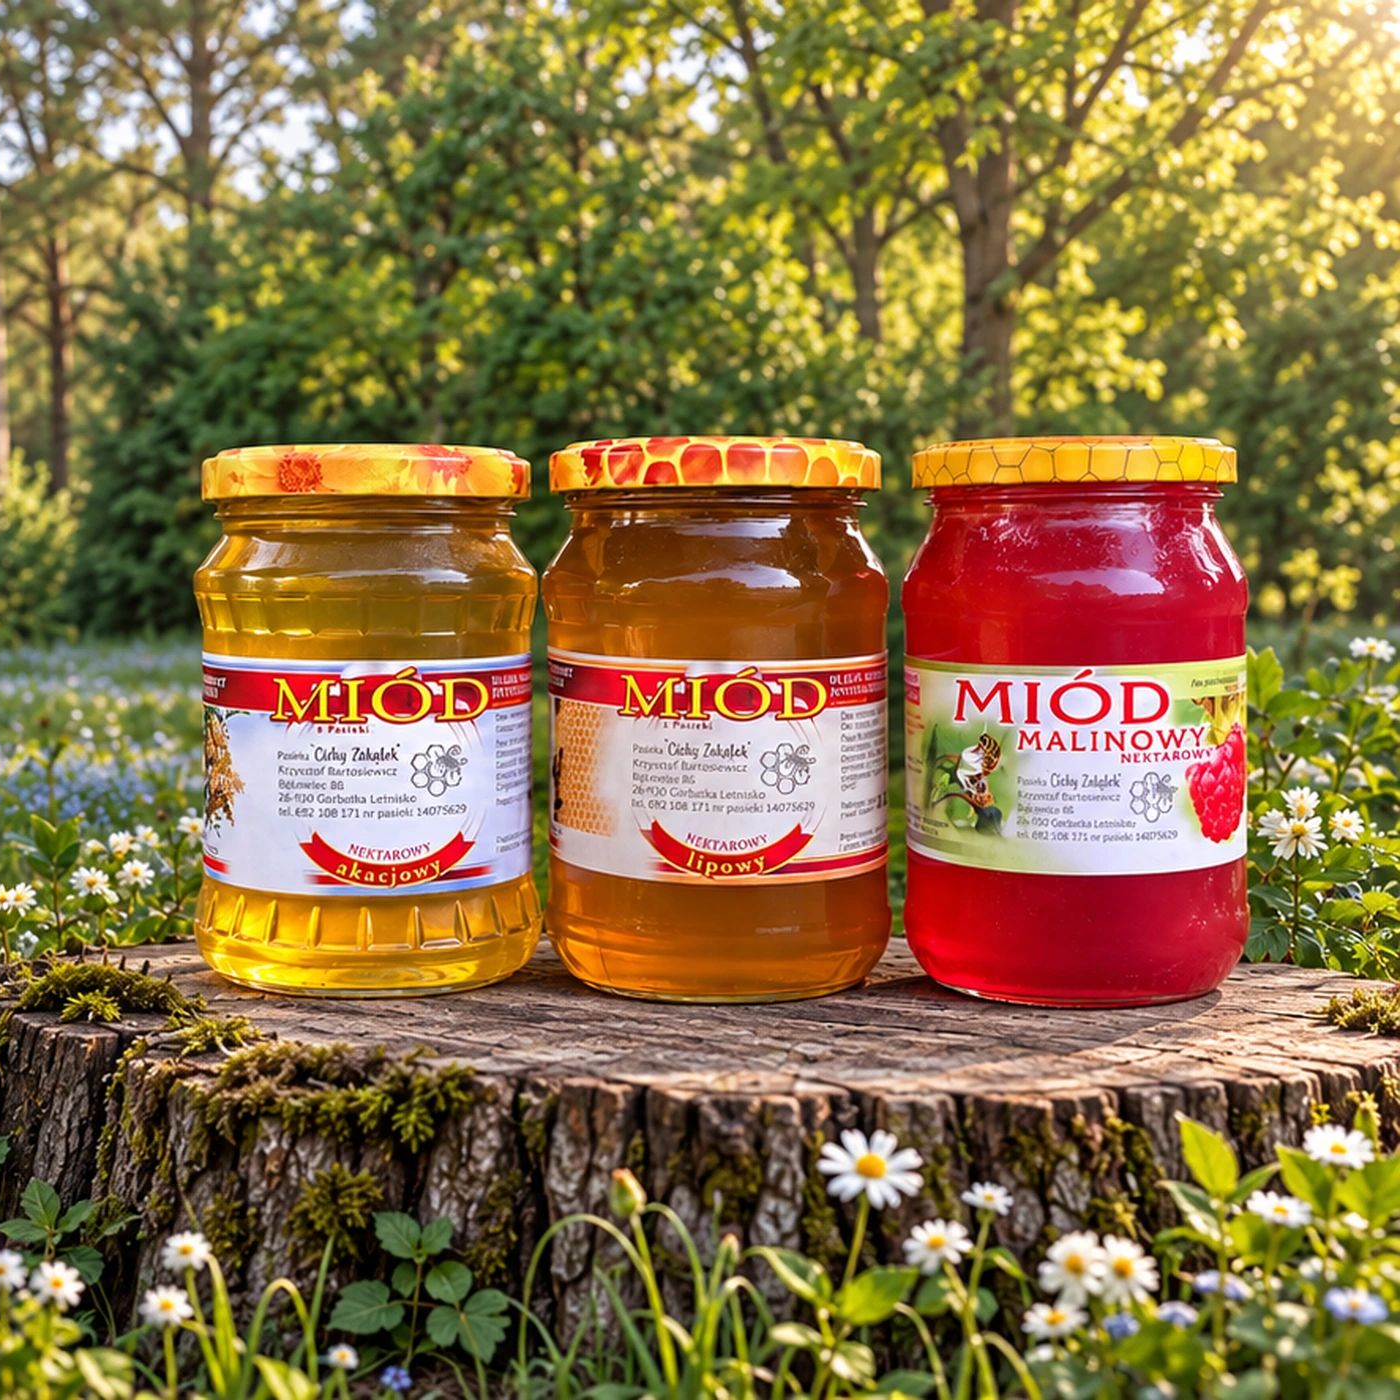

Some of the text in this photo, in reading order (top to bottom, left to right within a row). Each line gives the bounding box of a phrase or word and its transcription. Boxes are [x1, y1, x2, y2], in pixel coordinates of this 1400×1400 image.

[271, 667, 489, 723] MIÓD
[618, 667, 827, 721] MIÓD
[954, 668, 1170, 725] MIÓD
[1017, 726, 1206, 752] MALINOWY
[1120, 748, 1213, 763] NEKTAROWY
[341, 808, 360, 818] 171
[347, 842, 431, 862] NEKTAROWY
[685, 832, 768, 852] NEKTAROWY
[336, 860, 441, 888] akacjowy
[686, 850, 765, 877] lipowy
